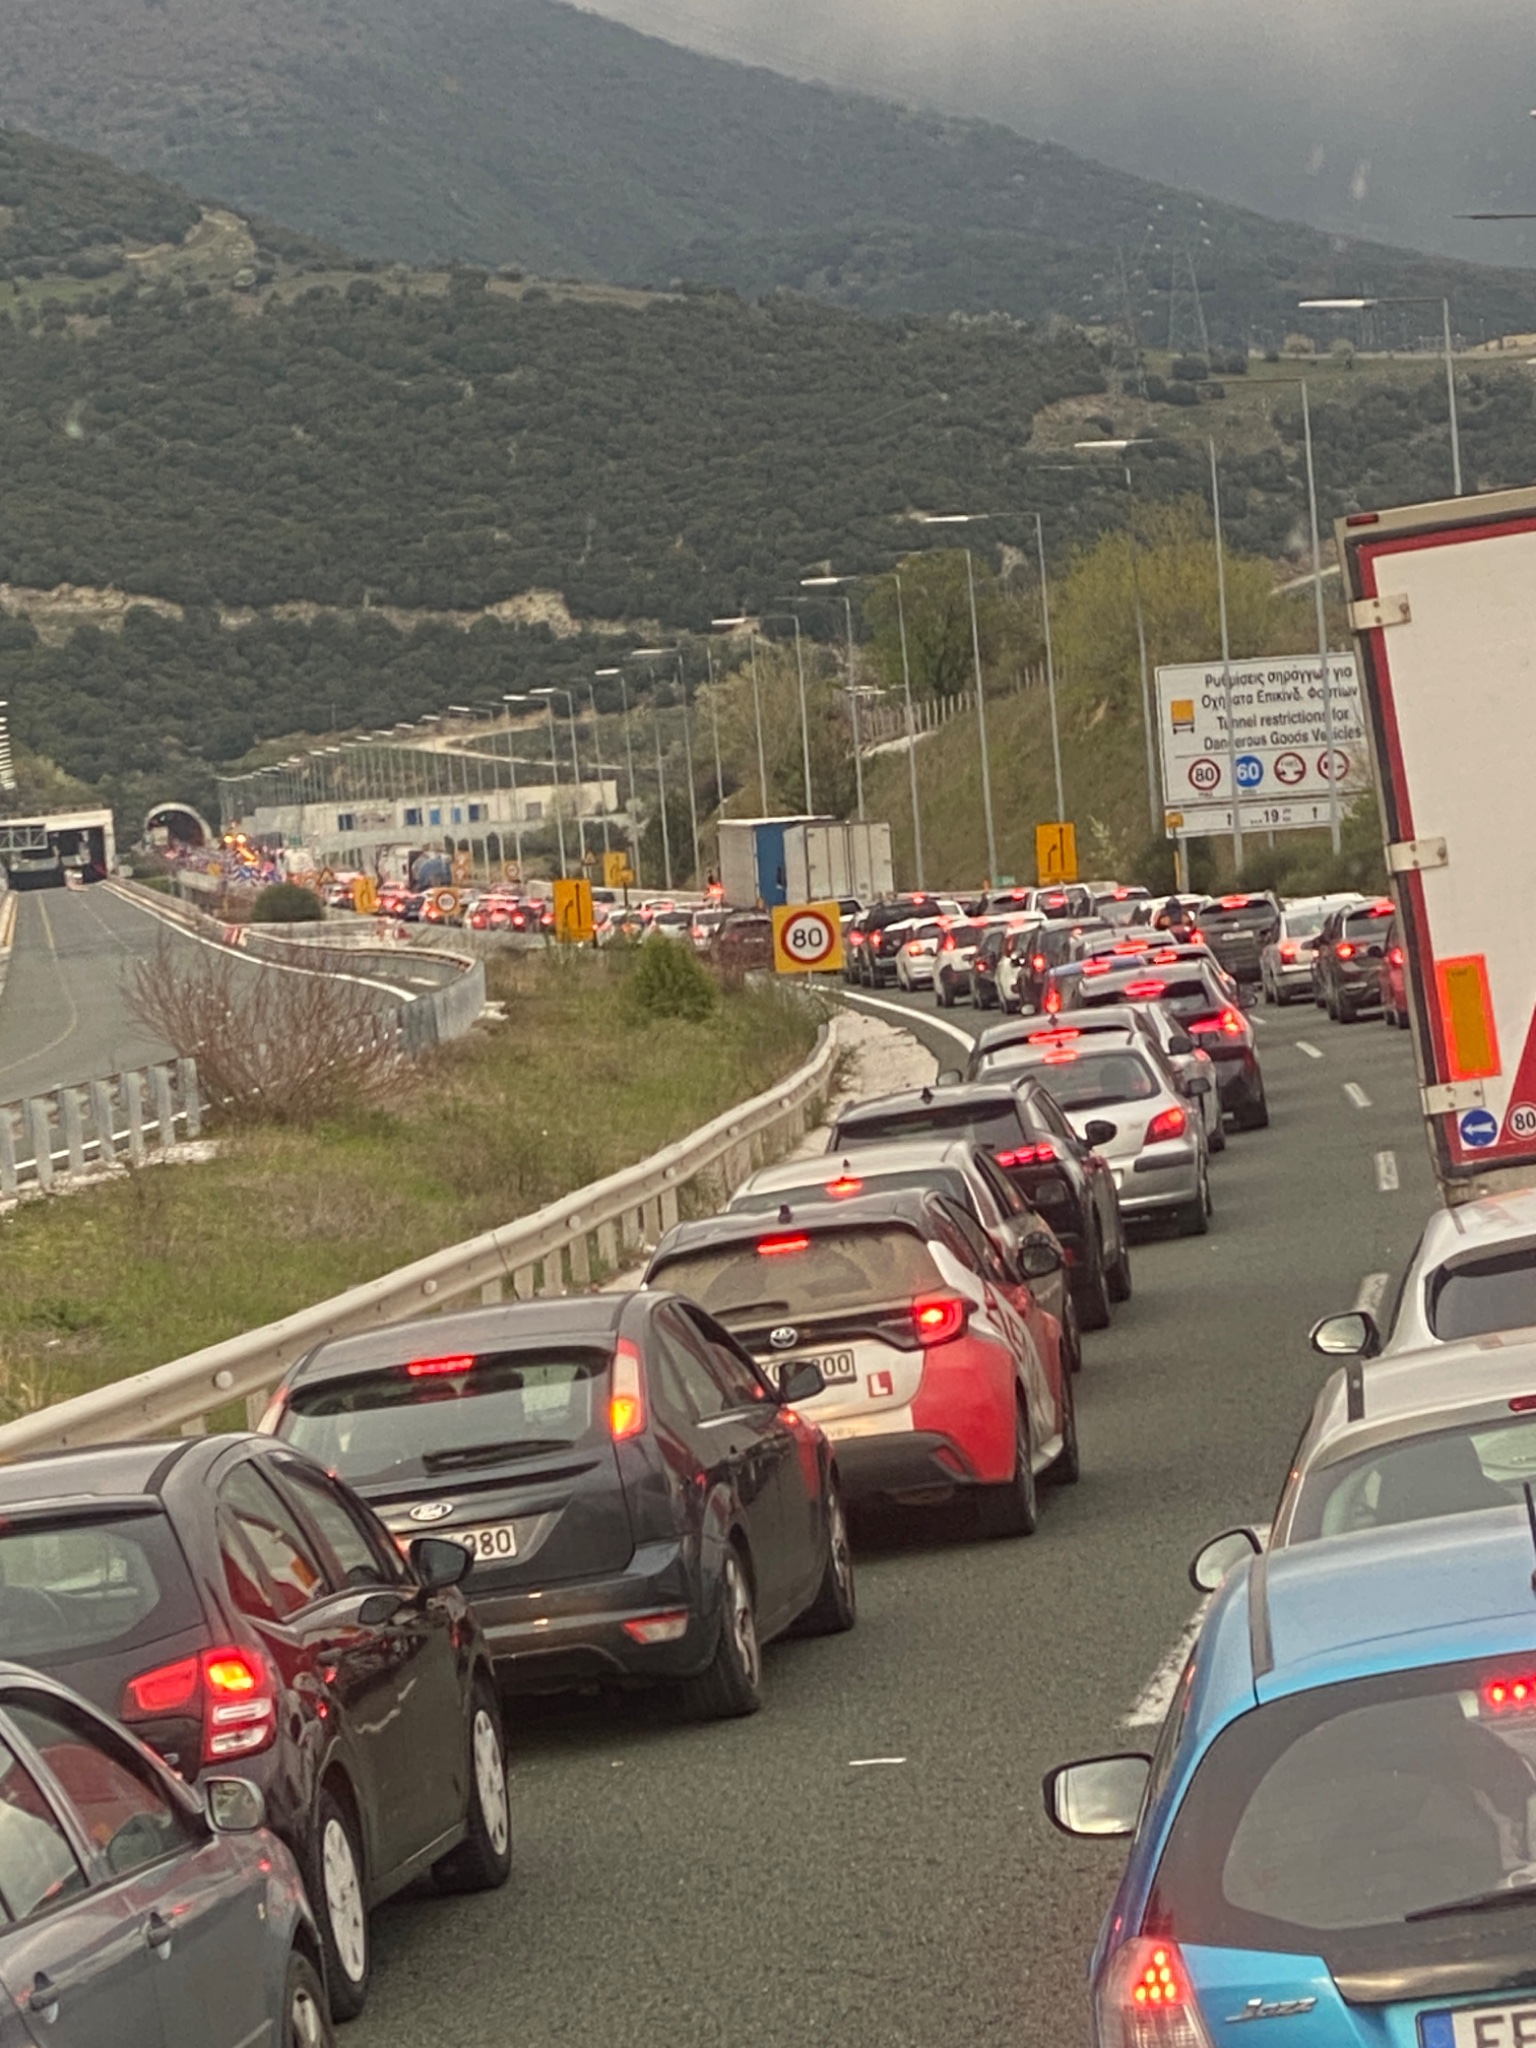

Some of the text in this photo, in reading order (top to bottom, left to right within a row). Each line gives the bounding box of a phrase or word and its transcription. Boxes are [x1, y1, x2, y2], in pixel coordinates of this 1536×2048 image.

[1333, 666, 1353, 682] για
[1201, 691, 1253, 711] Οχήατα
[1332, 706, 1349, 721] for
[1204, 725, 1361, 751] Danerous Goods Veicles
[1195, 767, 1214, 782] 80
[1237, 763, 1260, 781] 60
[793, 928, 822, 948] 80
[1515, 1111, 1536, 1131] 80
[871, 1373, 889, 1396] L
